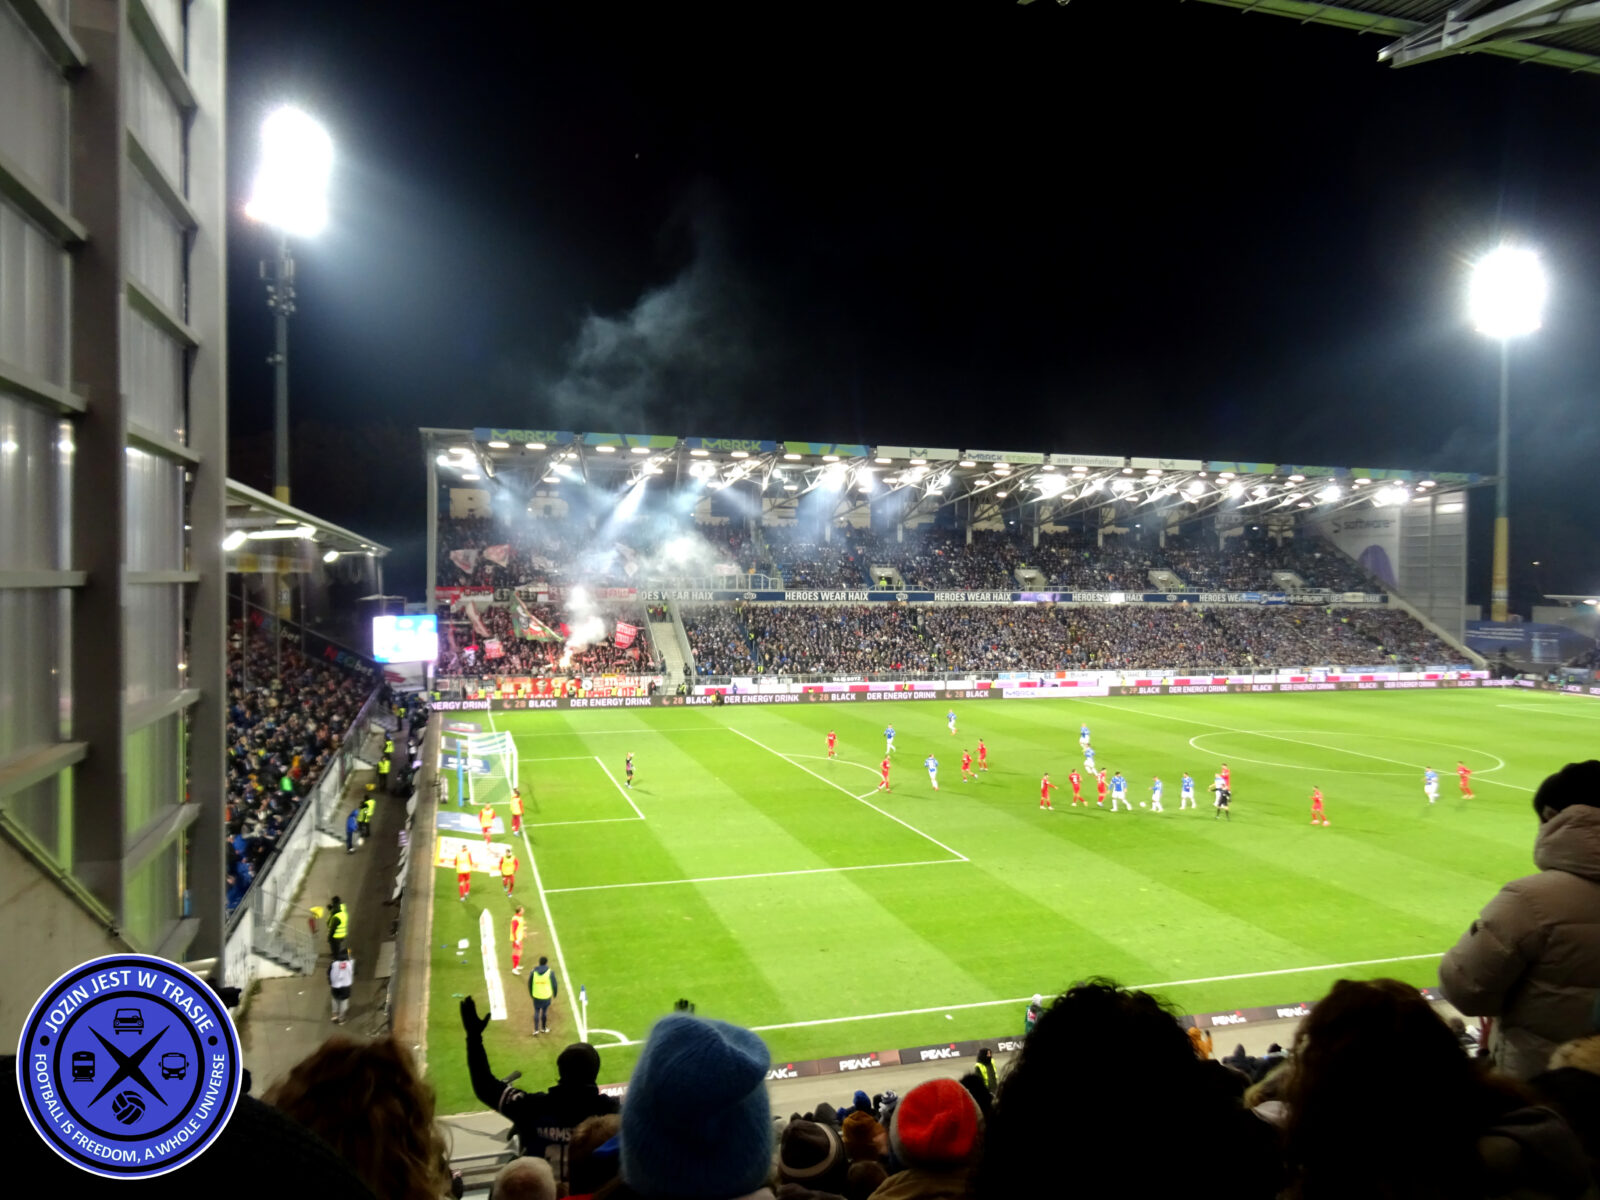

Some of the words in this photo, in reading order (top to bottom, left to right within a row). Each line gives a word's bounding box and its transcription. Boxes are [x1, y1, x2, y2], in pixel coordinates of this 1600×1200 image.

[701, 438, 762, 450] MERCK
[691, 591, 714, 600] HAIX
[785, 592, 819, 600] HEROES
[820, 592, 847, 600] WEAR
[848, 592, 868, 600] HAIX
[934, 592, 966, 600] HEROES
[967, 592, 991, 600] WEAR
[992, 592, 1012, 600] HAIX
[1072, 592, 1100, 601] HEROES
[1126, 592, 1144, 601] HAIX
[1200, 594, 1226, 602] HEROES
[724, 696, 741, 704] DER
[742, 694, 773, 703] ENERGY
[774, 694, 799, 702] DRINK
[914, 691, 936, 699] DRINK
[431, 701, 460, 710] NERGY
[528, 700, 558, 708] BLACK
[570, 699, 588, 708] DER
[590, 698, 624, 706] ENERGY
[625, 696, 652, 705] DRINK
[998, 1040, 1024, 1052] PEA
[920, 1048, 951, 1060] PEAK
[839, 1058, 872, 1071] PEAK
[766, 1068, 788, 1080] EAK
